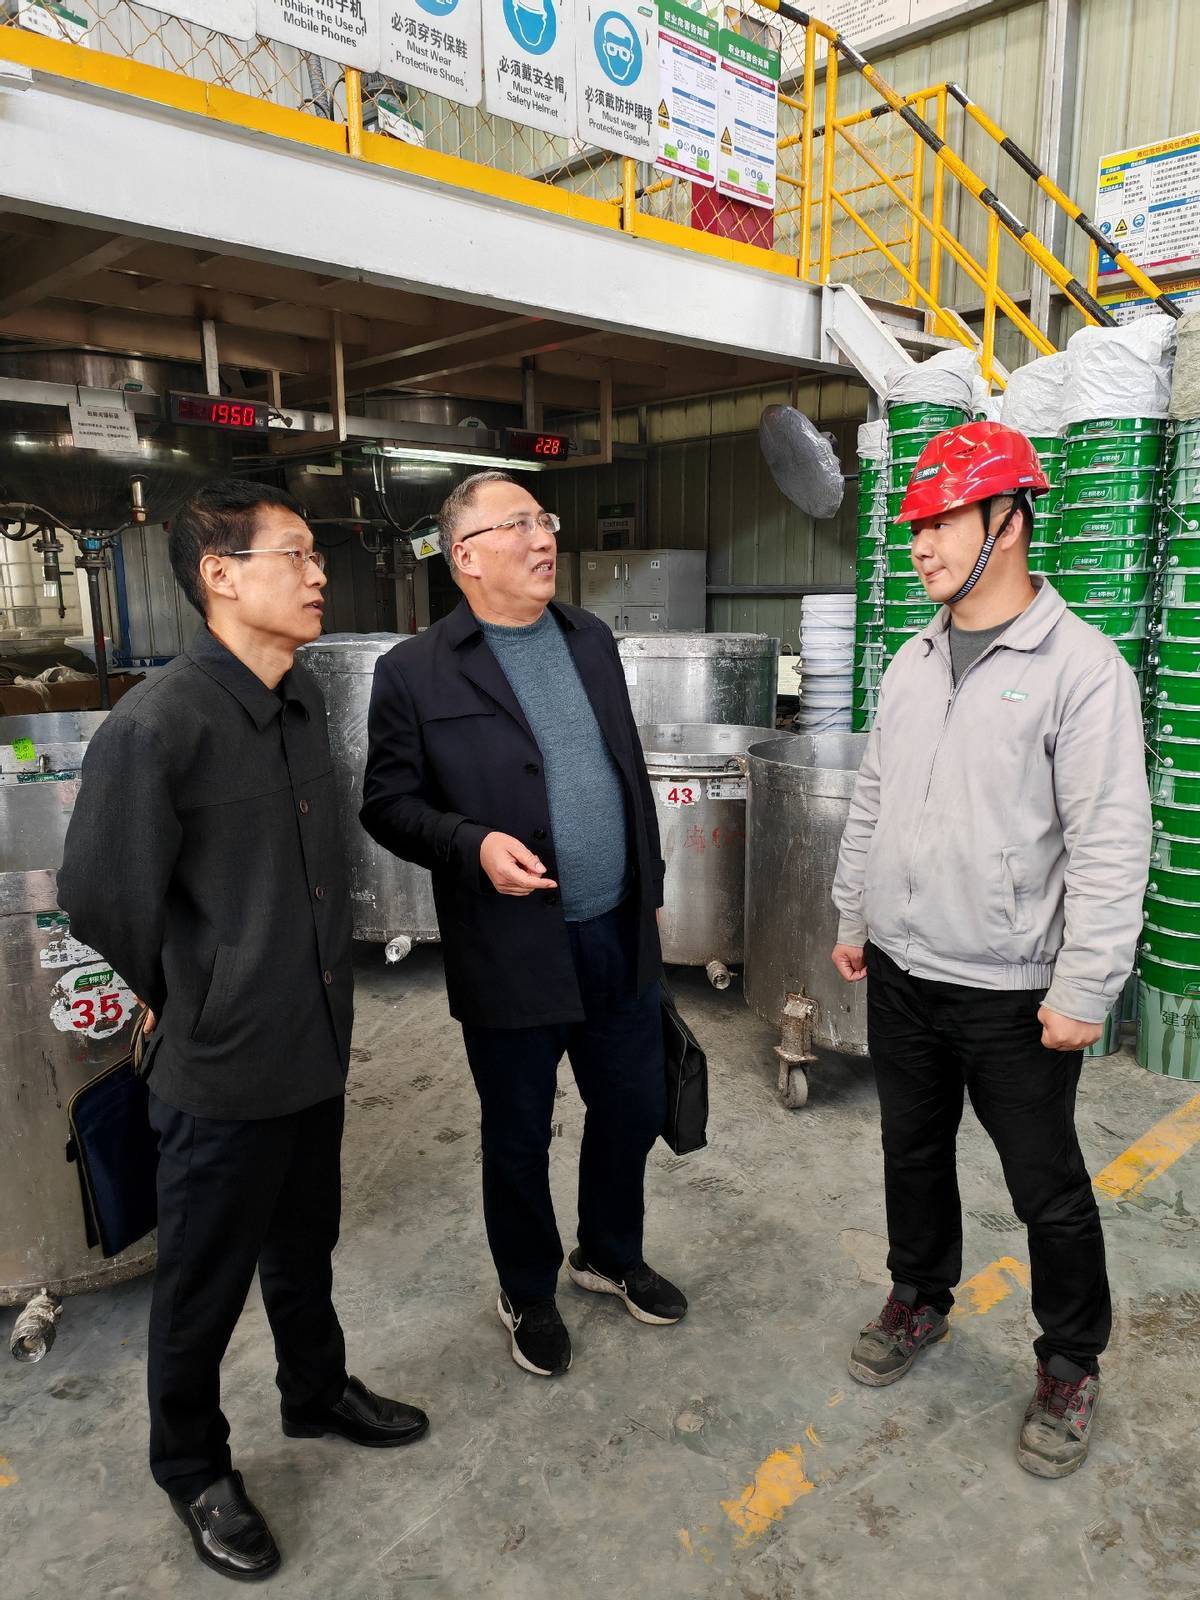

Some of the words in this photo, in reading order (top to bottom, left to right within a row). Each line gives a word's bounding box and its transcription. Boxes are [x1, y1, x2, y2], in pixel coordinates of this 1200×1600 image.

[283, 10, 319, 34] Mobile
[321, 24, 357, 48] Phones
[316, 9, 333, 24] the
[335, 15, 354, 32] Use
[355, 22, 366, 37] of
[391, 12, 468, 59] 必须穿劳保鞋
[406, 39, 428, 58] Must
[430, 48, 452, 67] Wear
[395, 50, 438, 76] Protective
[439, 68, 465, 87] Shoes
[499, 55, 565, 94] 必须戴安全帽
[506, 91, 531, 110] Safety
[532, 99, 558, 118] Helmet
[512, 80, 533, 96] Must
[533, 88, 552, 102] wear
[584, 85, 653, 126] 必须戴防护眼镜
[588, 118, 623, 138] Protective
[623, 130, 650, 147] Goggles
[601, 110, 620, 125] Must
[620, 117, 637, 131] wear
[211, 403, 255, 427] 1950
[535, 437, 560, 455] 228
[667, 787, 693, 805] 43
[71, 992, 123, 1029] 35
